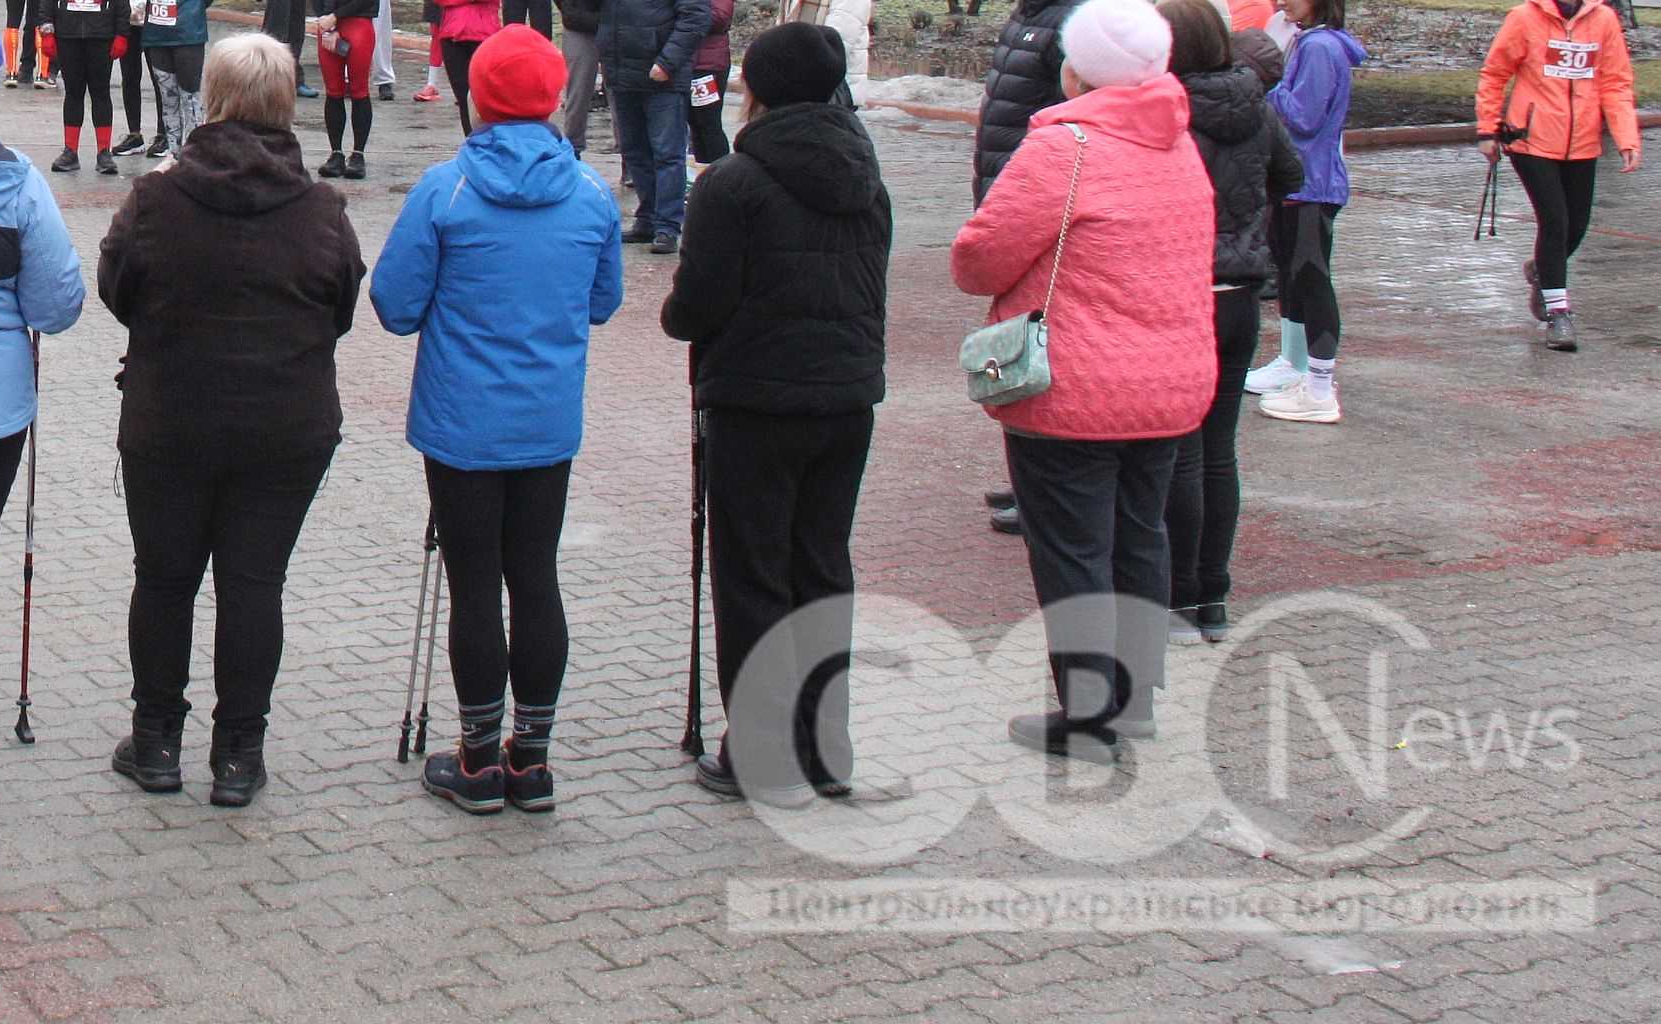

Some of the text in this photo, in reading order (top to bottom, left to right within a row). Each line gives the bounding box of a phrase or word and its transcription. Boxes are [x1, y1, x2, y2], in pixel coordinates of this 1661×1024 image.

[151, 4, 169, 18] 06
[1557, 50, 1588, 69] 30
[690, 84, 709, 97] 23
